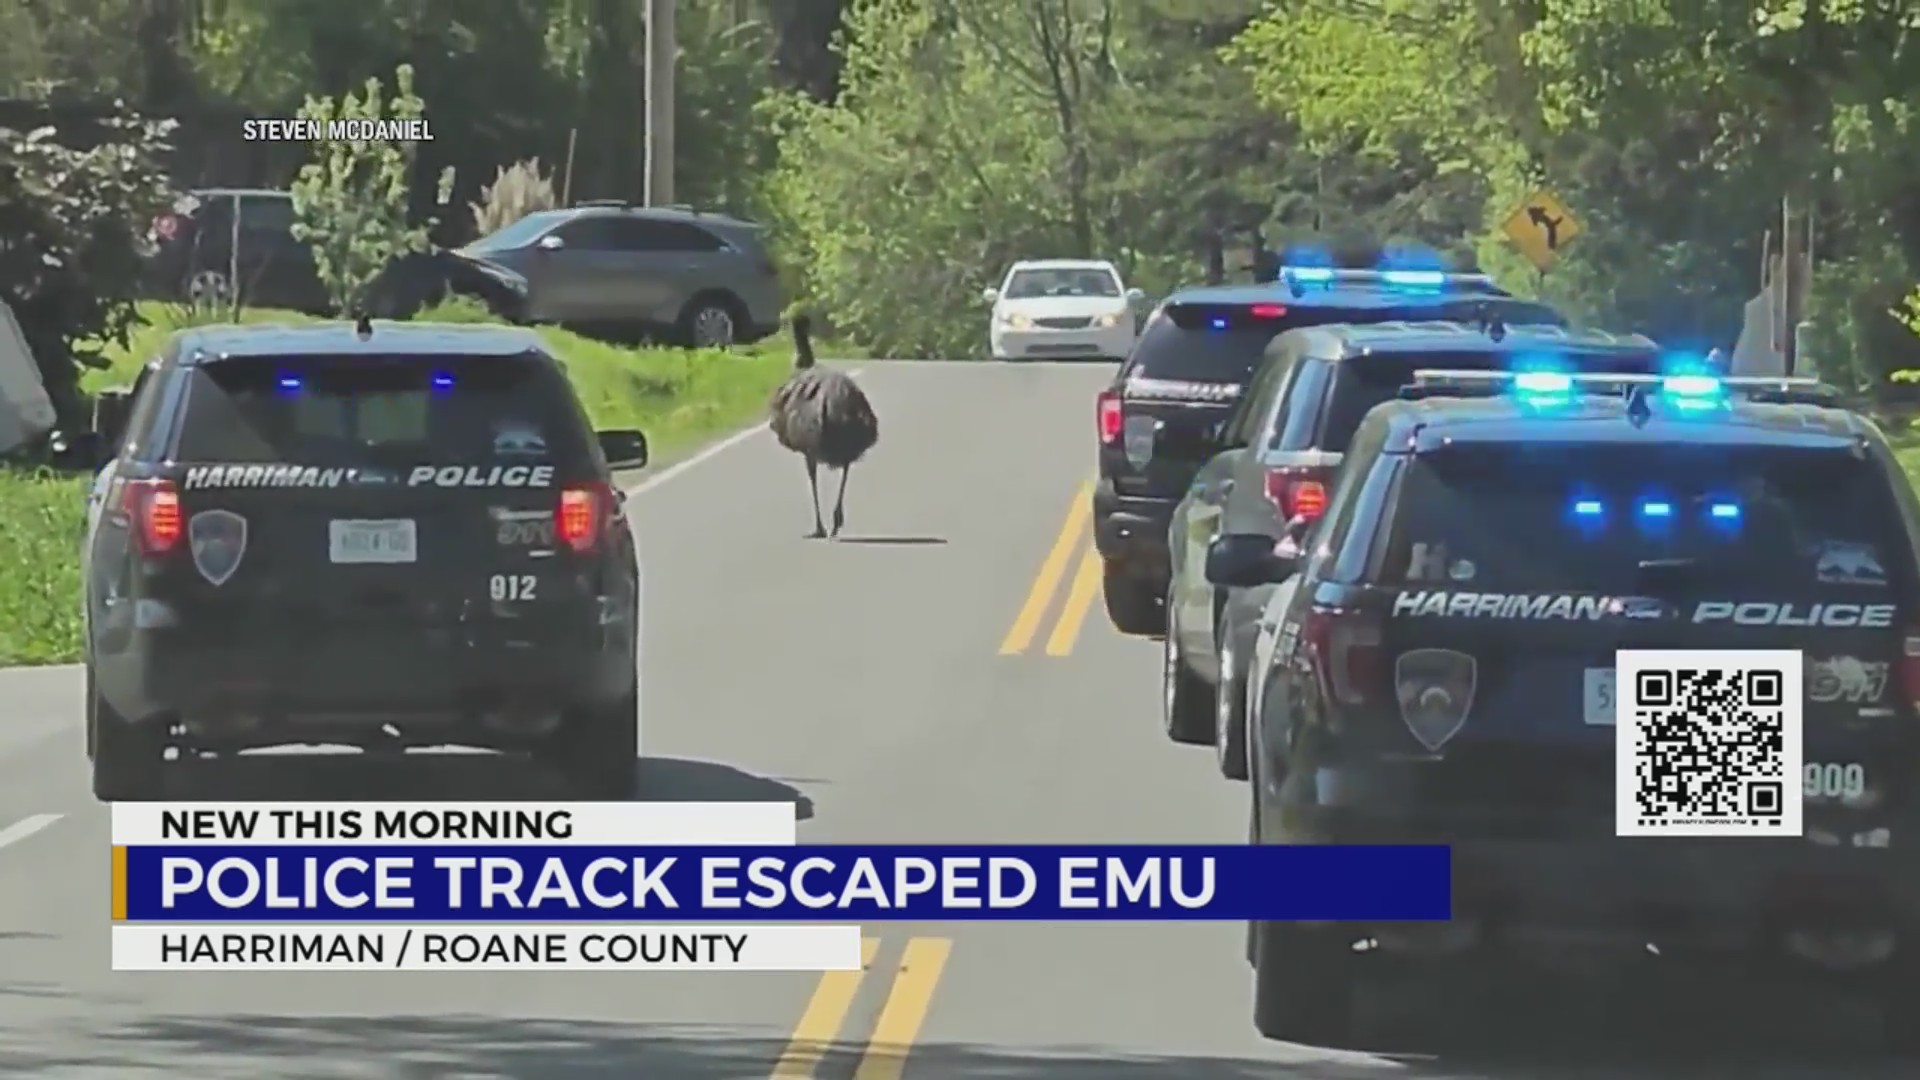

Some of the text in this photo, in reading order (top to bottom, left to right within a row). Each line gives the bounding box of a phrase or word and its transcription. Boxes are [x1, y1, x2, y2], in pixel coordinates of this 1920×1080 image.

[184, 465, 555, 490] HARRIMAN POLICE
[490, 574, 537, 602] 912
[1392, 591, 1897, 627] HARRIMAN POLICE
[1803, 762, 1864, 797] 909
